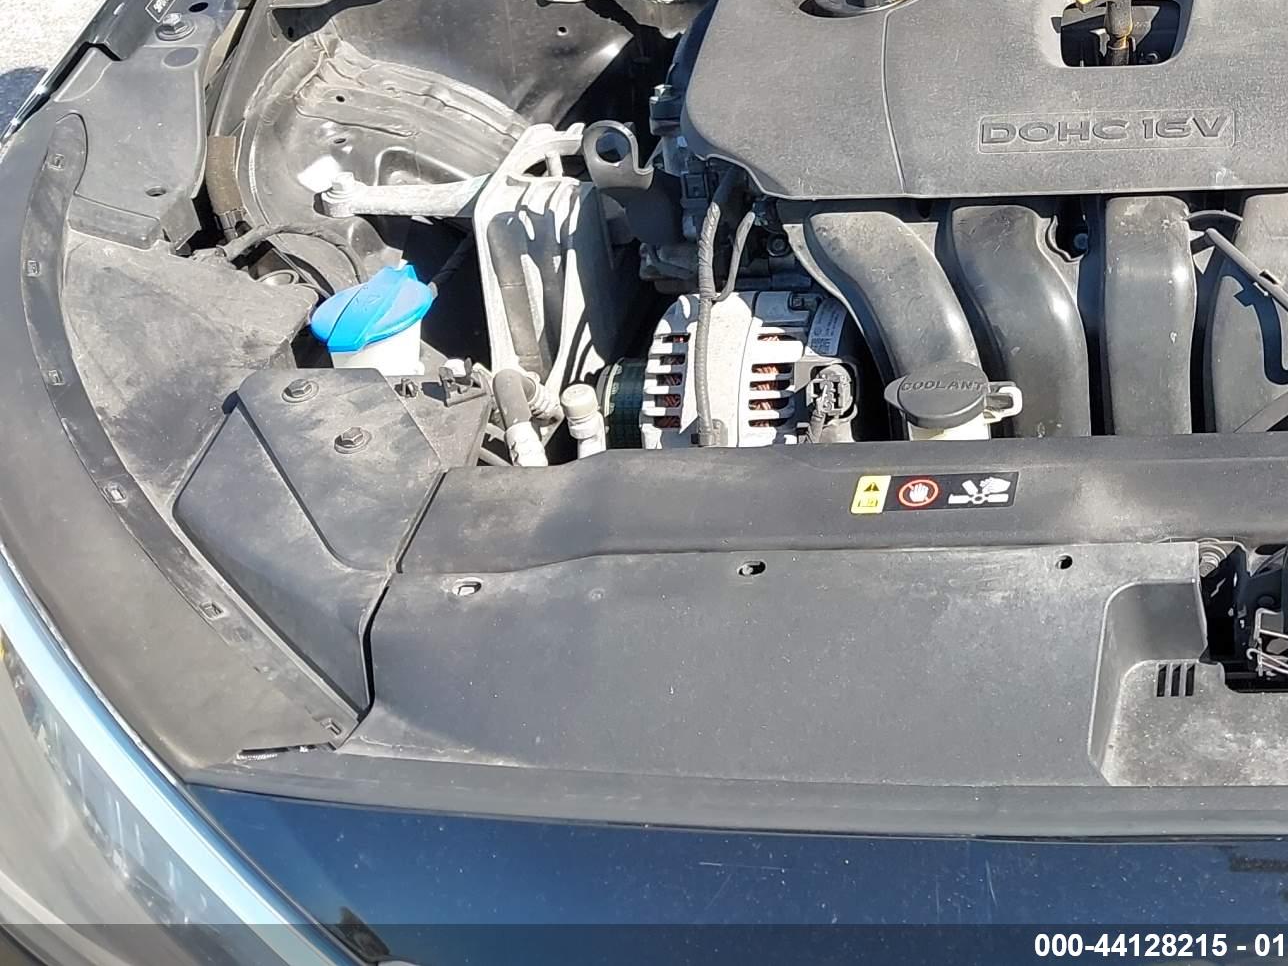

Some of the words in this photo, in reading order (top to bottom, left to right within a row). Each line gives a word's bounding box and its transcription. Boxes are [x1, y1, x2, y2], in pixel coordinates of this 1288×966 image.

[981, 119, 1129, 145] DOHC
[1142, 114, 1229, 139] 16V
[901, 379, 985, 392] COOLANT
